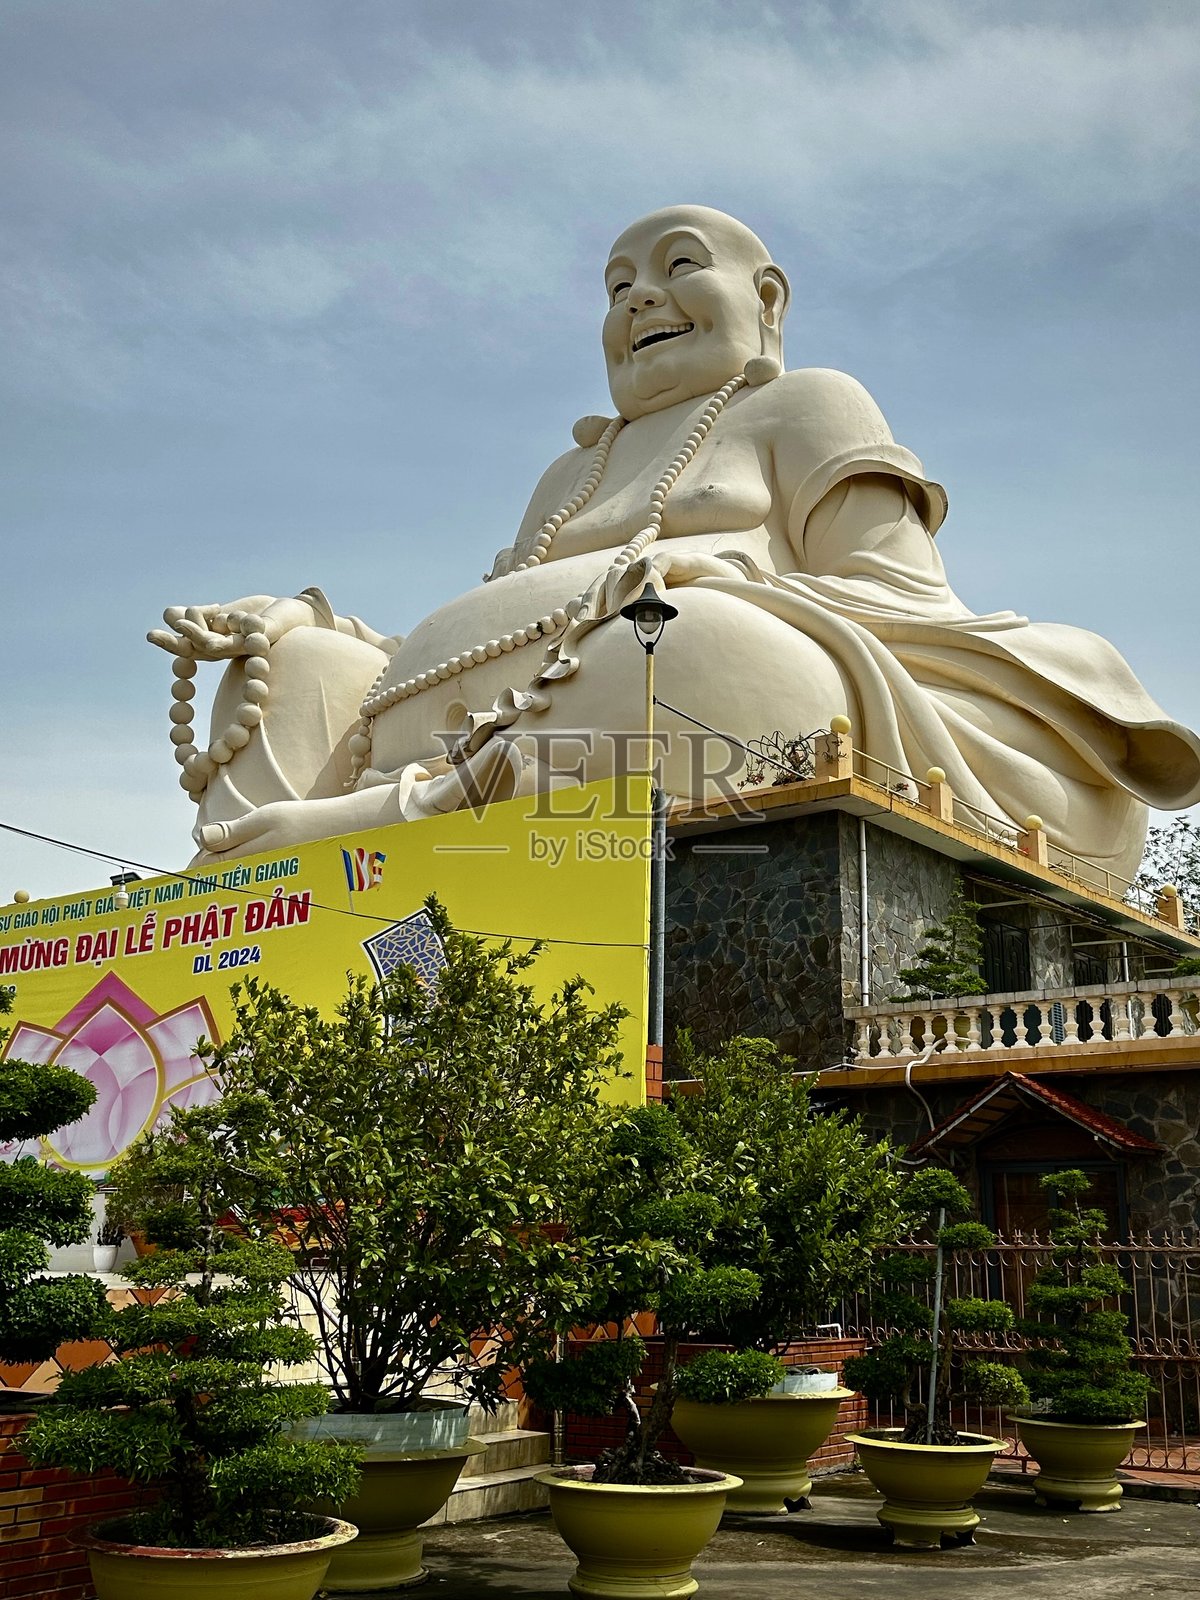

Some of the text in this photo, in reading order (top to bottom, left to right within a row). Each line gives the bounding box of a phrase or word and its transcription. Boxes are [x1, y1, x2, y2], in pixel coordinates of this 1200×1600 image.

[14, 909, 39, 929] GIÁO
[41, 904, 61, 927] HỘI
[63, 899, 93, 921] PHẬT
[95, 893, 121, 915] GIÁ
[126, 887, 152, 911] VIỆT
[154, 882, 184, 904] NAM
[222, 864, 252, 889] TIỀN
[255, 857, 299, 882] GIANG
[0, 887, 311, 974] MỪNG ĐẠI LỄ PHẬT ĐẢN
[193, 945, 261, 974] DL 2024
